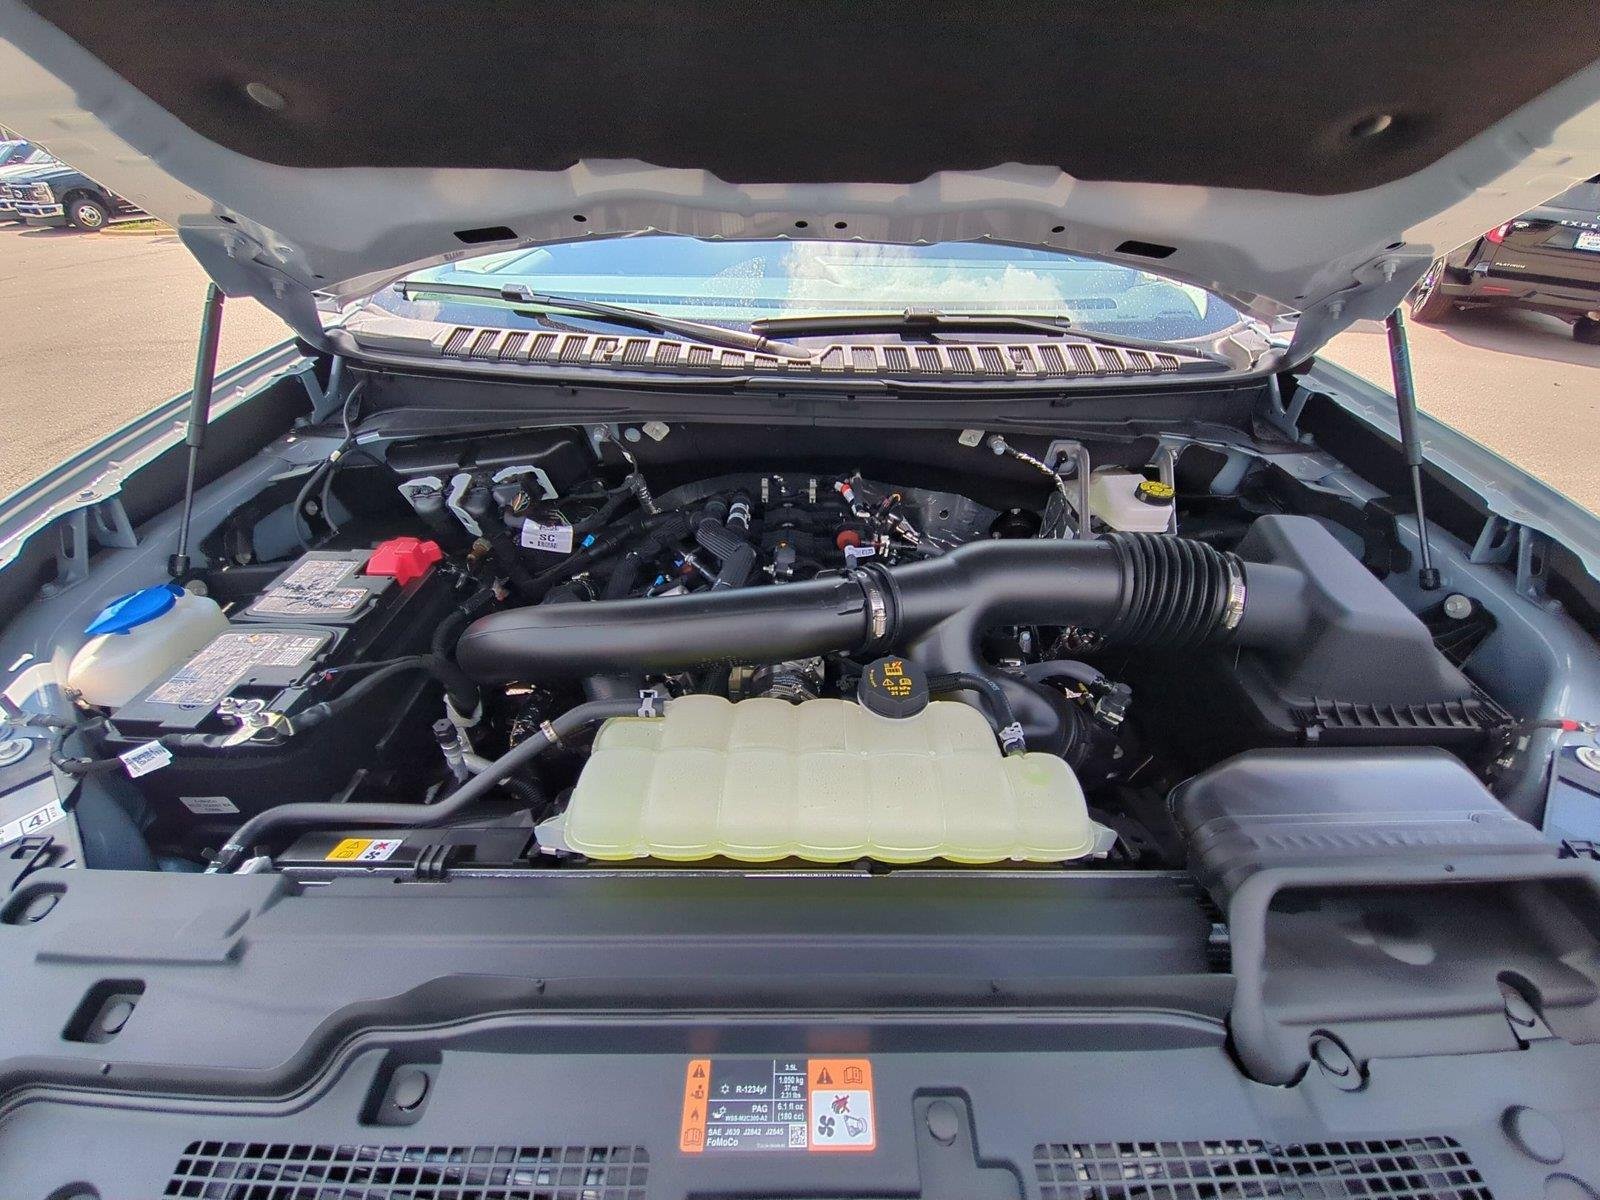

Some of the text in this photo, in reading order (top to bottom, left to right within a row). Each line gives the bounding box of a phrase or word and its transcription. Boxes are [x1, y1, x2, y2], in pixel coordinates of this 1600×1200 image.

[539, 533, 556, 543] SC
[29, 814, 44, 828] 4
[795, 1076, 804, 1086] kg
[735, 1085, 767, 1095] R-1234yf
[751, 1104, 768, 1113] PAG
[793, 1112, 805, 1122] cc)
[708, 1128, 722, 1136] SAE
[706, 1137, 739, 1147] FoMoCo
